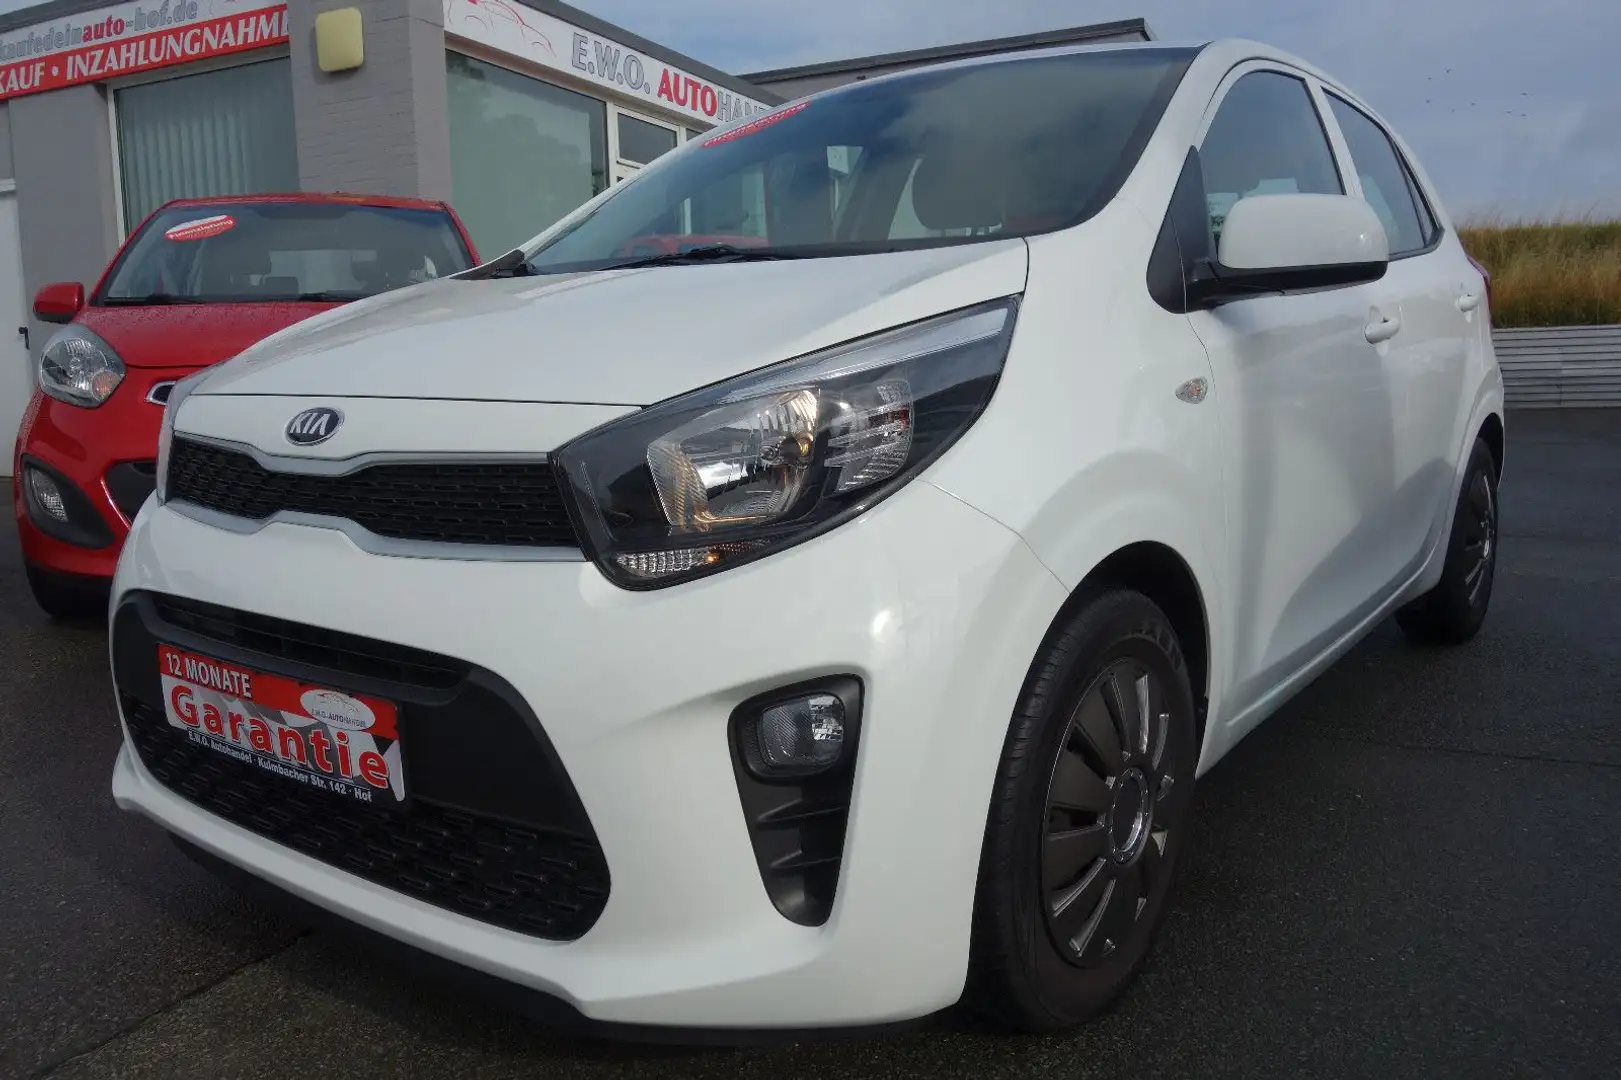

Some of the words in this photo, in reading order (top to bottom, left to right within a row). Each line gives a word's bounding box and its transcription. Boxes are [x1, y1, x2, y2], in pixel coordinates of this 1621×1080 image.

[571, 32, 651, 94] E.W.O.
[657, 67, 767, 122] AUTOHAN
[289, 412, 331, 436] KIA
[166, 652, 182, 677] 12
[185, 659, 253, 699] MONATE
[170, 684, 390, 789] Garantie
[257, 756, 309, 784] Kulmbacher
[310, 773, 328, 790] Str.
[329, 780, 348, 796] 142
